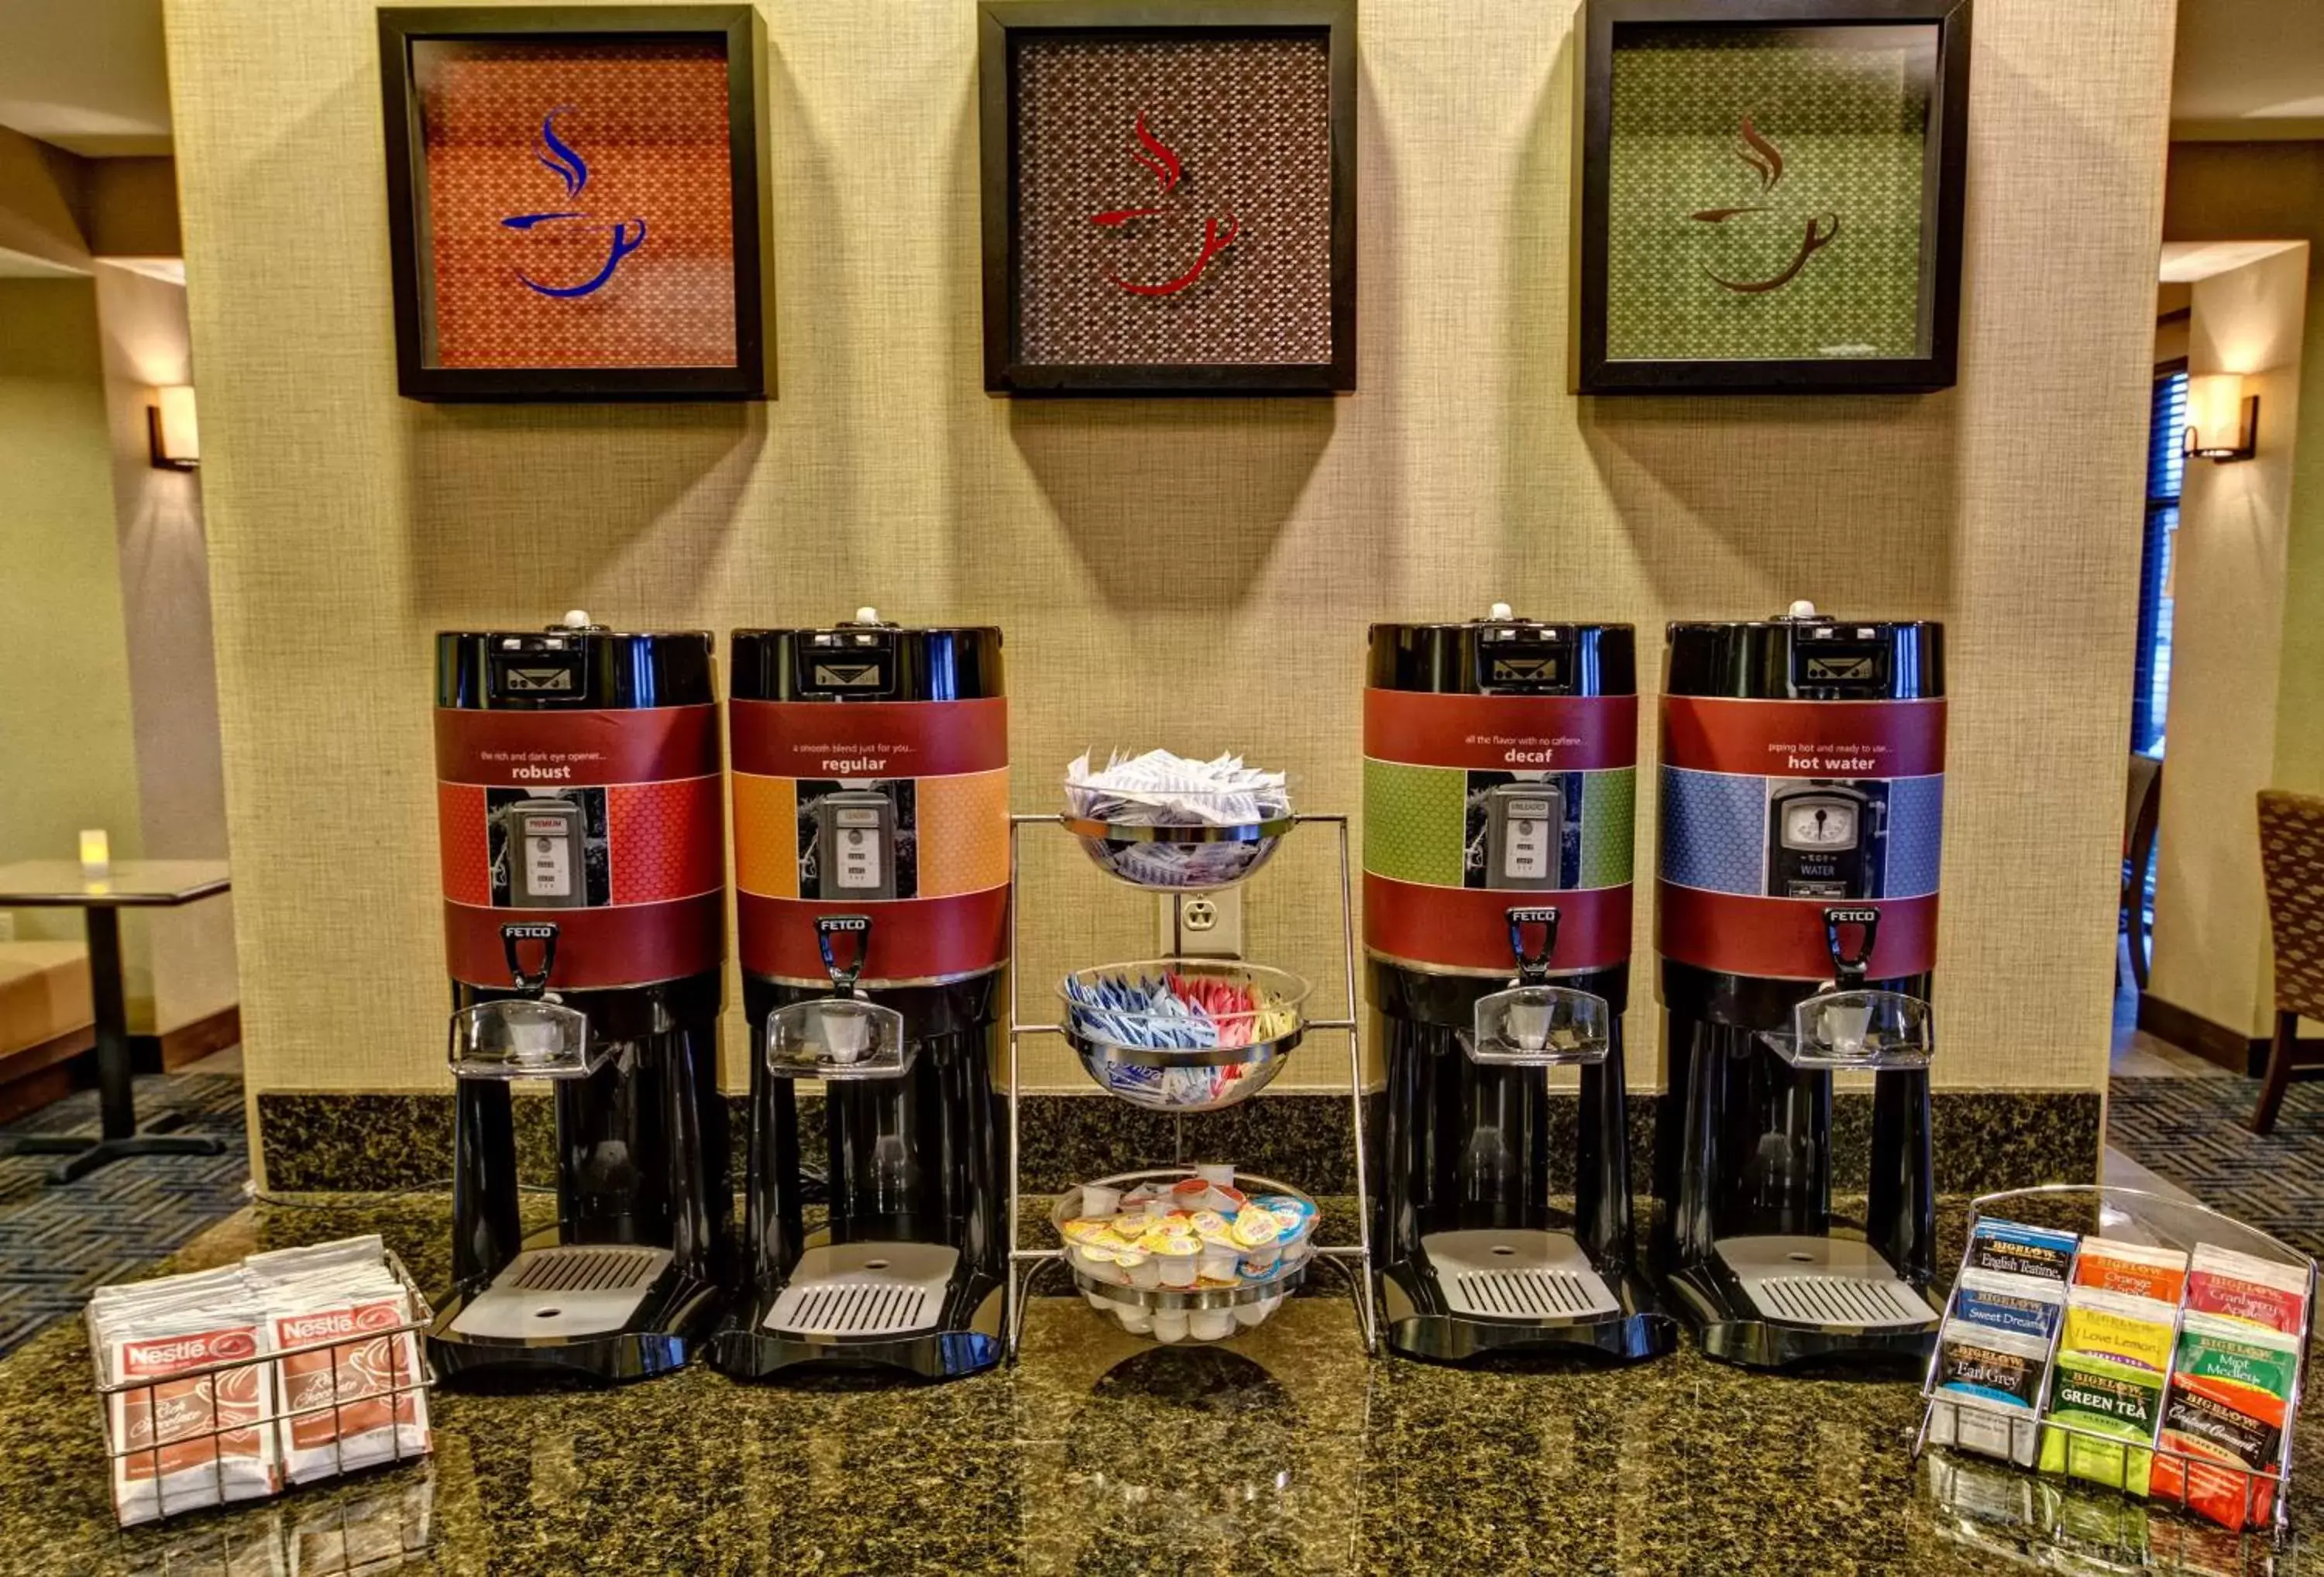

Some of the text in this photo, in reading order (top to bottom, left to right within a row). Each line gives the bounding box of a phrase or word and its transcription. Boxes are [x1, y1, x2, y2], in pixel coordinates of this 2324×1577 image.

[1465, 735, 1476, 744] all
[1477, 735, 1491, 744] the
[1492, 735, 1516, 744] flavor
[1518, 736, 1537, 745] with
[832, 744, 858, 752] blend
[859, 744, 875, 754] just
[877, 743, 891, 752] for
[1504, 748, 1553, 763] decaf
[1768, 744, 1796, 754] piping
[1798, 743, 1815, 752] hot
[1817, 744, 1834, 752] and
[1835, 744, 1859, 754] ready
[494, 751, 509, 761] rich
[511, 751, 526, 761] and
[528, 751, 548, 761] dark
[549, 754, 566, 763] eye
[1787, 755, 1875, 770] hot water
[512, 764, 571, 779] robust
[822, 756, 887, 774] regular
[1800, 865, 1835, 875] WATER
[1513, 912, 1556, 921] FETCO
[1831, 912, 1875, 921] FETCO
[506, 927, 552, 937] FETCO
[820, 919, 865, 930] FETCO
[1982, 1252, 2018, 1271] English
[2104, 1271, 2152, 1289] Orange
[2209, 1287, 2278, 1314] Cranberry
[1968, 1307, 2002, 1322] Sweet
[2082, 1328, 2113, 1345] Love
[2219, 1353, 2250, 1369] Mint
[1957, 1362, 2020, 1390] Earl Grey
[2072, 1371, 2143, 1395] BIGELOW
[2061, 1388, 2147, 1420] GREEN TEA
[2185, 1392, 2260, 1429] BIGELOW
